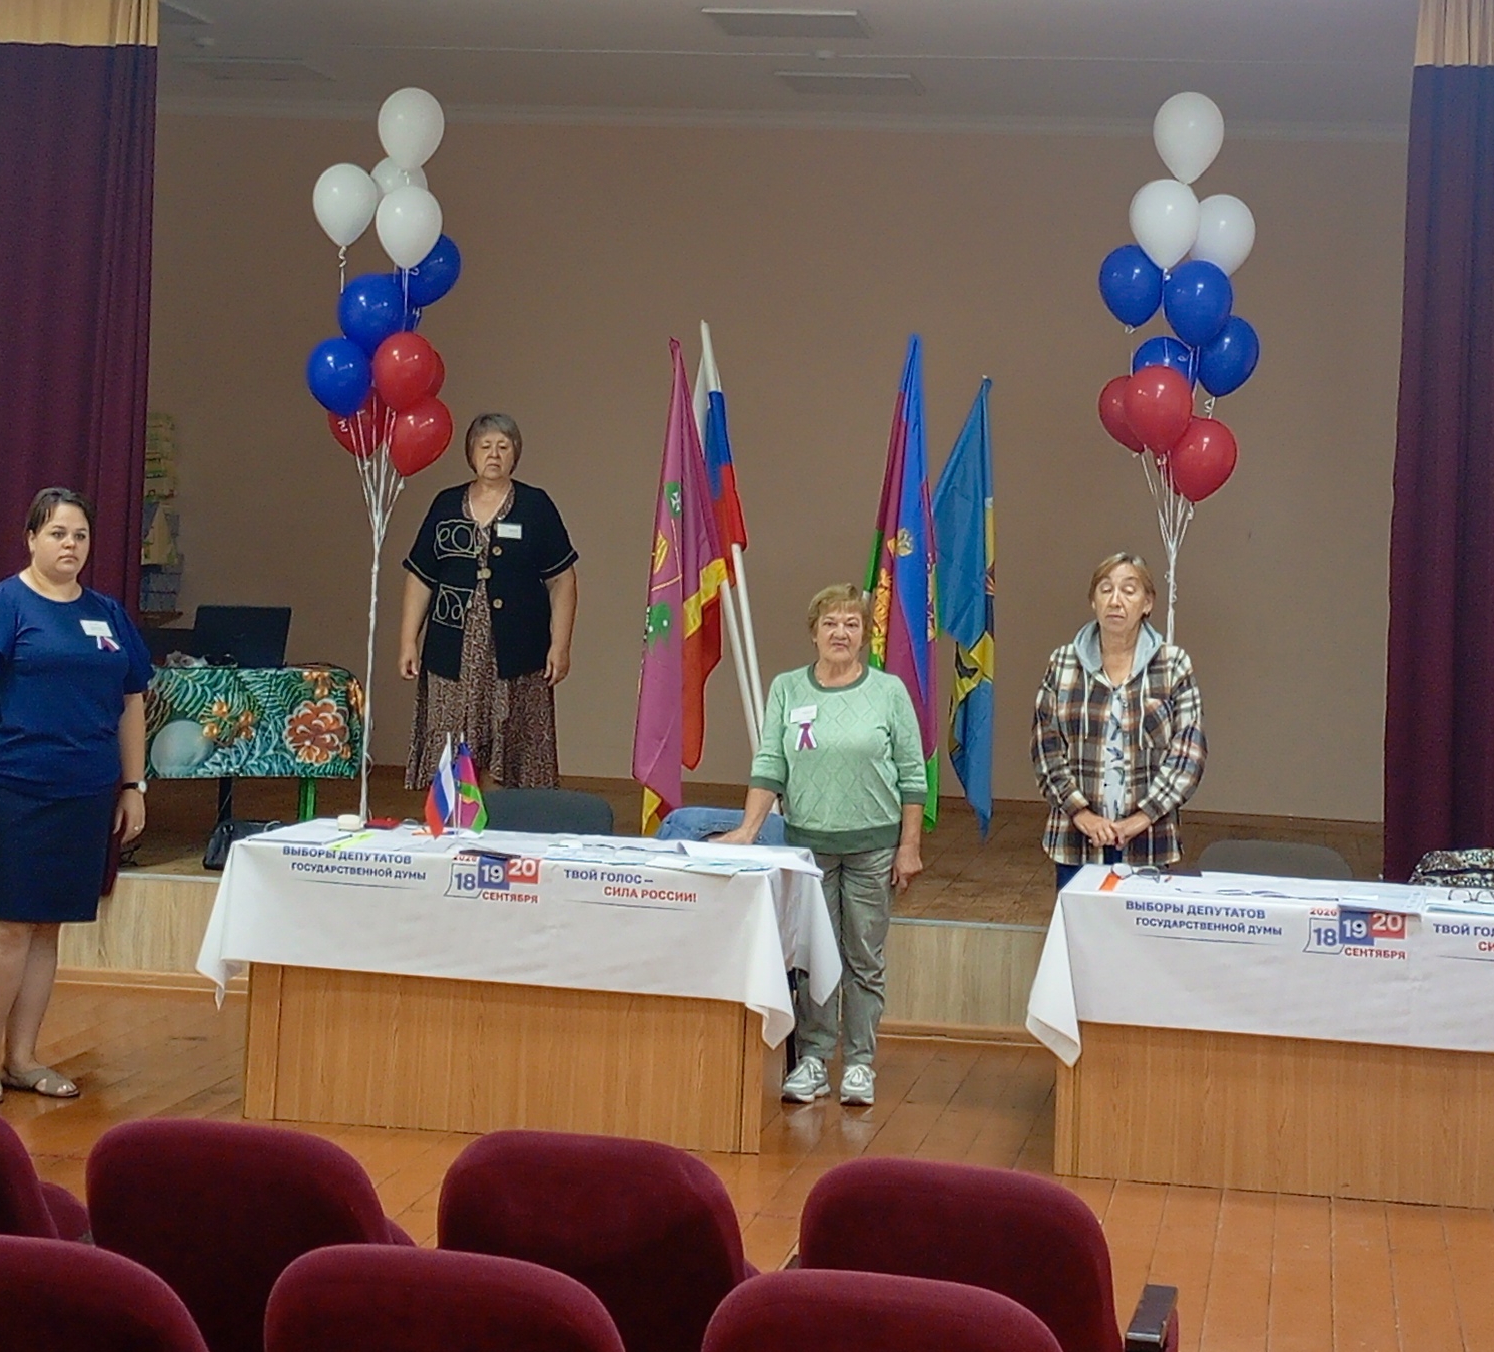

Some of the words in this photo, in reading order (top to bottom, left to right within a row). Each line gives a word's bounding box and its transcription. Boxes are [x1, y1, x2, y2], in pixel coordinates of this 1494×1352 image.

[282, 845, 336, 859] ВЫБОРЫ
[338, 851, 412, 864] ДЕПУТАТОВ
[291, 862, 392, 878] ГОСУДАРСТВЕННОЙ
[394, 870, 426, 881] ДУМЫ
[454, 873, 476, 890] 18
[481, 865, 504, 883] 19
[508, 859, 536, 877] 20
[564, 868, 598, 880] ТВОЙ
[600, 872, 642, 884] ГОЛОС
[482, 891, 538, 903] СЕНТЯБРЯ
[604, 886, 638, 898] СИЛА
[641, 890, 697, 902] РОССИИ!
[1126, 900, 1184, 914] ВЫБОРЫ
[1186, 905, 1266, 919] ДЕПУТАТОВ
[1136, 917, 1245, 933] ГОСУДАРСТВЕННОЙ
[1247, 925, 1282, 936] ДУМЫ
[1313, 927, 1337, 946] 18
[1342, 919, 1367, 939] 19
[1372, 913, 1402, 931] 20
[1433, 923, 1470, 935] ТВОЙ
[1344, 947, 1406, 960] СЕНТЯБРЯ
